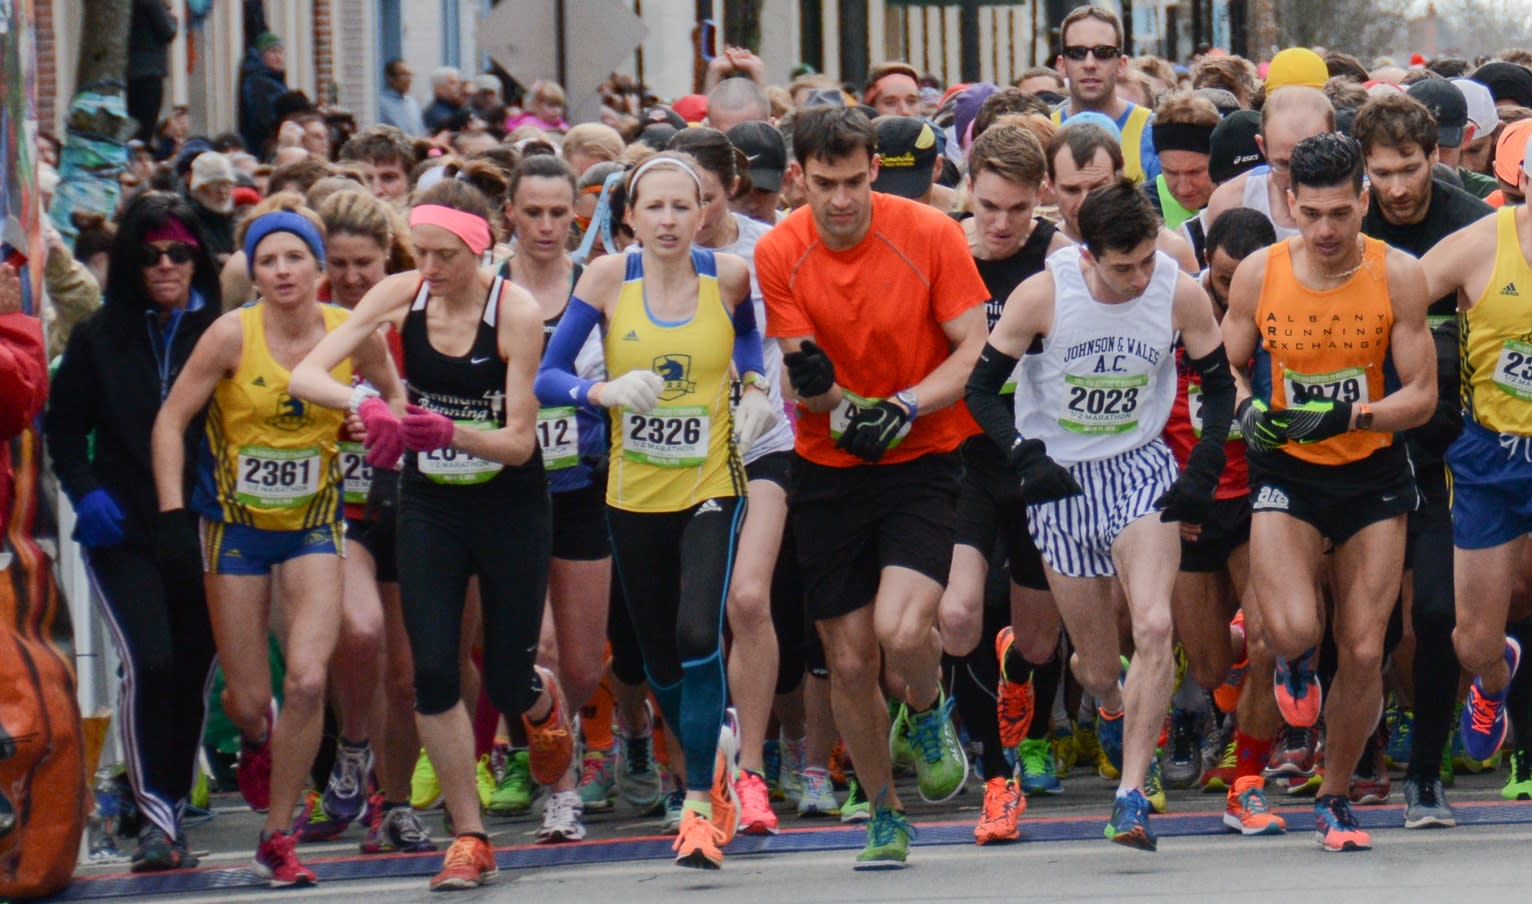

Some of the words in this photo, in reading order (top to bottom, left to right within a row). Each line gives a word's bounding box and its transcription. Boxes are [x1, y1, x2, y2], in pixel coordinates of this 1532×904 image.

[1266, 312, 1384, 323] ALBANY
[1267, 326, 1384, 337] RUNNING
[1064, 336, 1116, 362] JOHNSON
[1127, 338, 1160, 366] WALES
[1093, 354, 1128, 373] A.C.
[418, 398, 489, 421] Running
[1068, 386, 1139, 415] 2023
[1085, 412, 1132, 421] MARATHON
[630, 416, 700, 446] 2326
[648, 442, 696, 453] MARATHON
[245, 458, 310, 487] 2361
